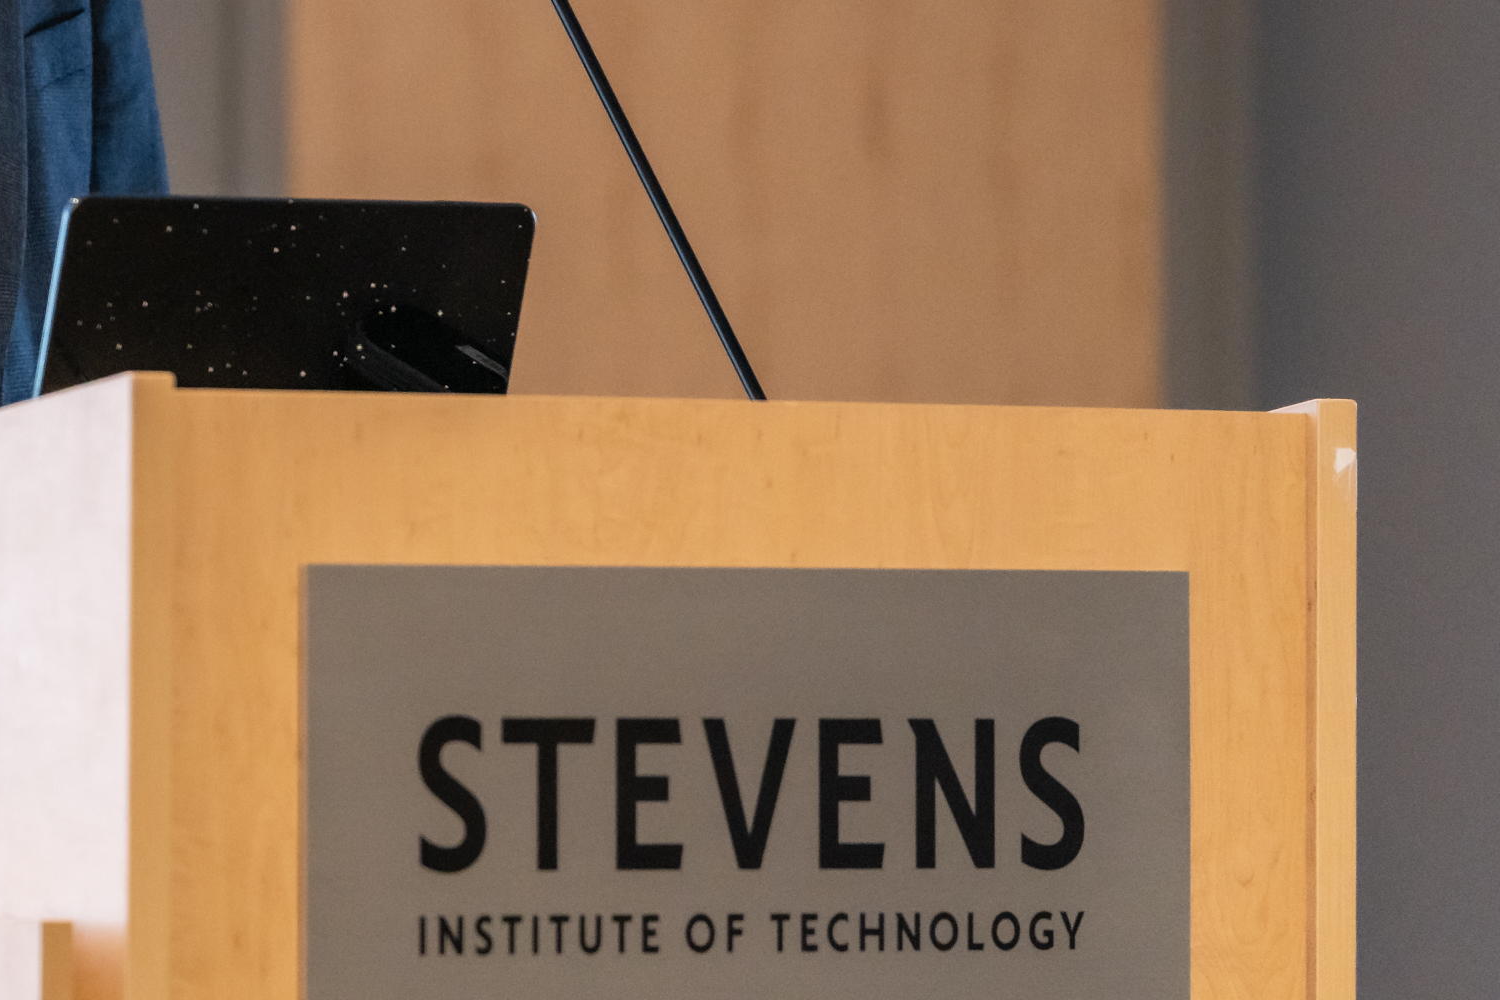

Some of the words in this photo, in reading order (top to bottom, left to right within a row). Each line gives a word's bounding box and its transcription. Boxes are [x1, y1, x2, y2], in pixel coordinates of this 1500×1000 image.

[416, 714, 1086, 874] STEVENS
[418, 913, 660, 956] INSTITUTE
[684, 912, 745, 954] OF
[769, 910, 1085, 953] TECHNOLOGY
